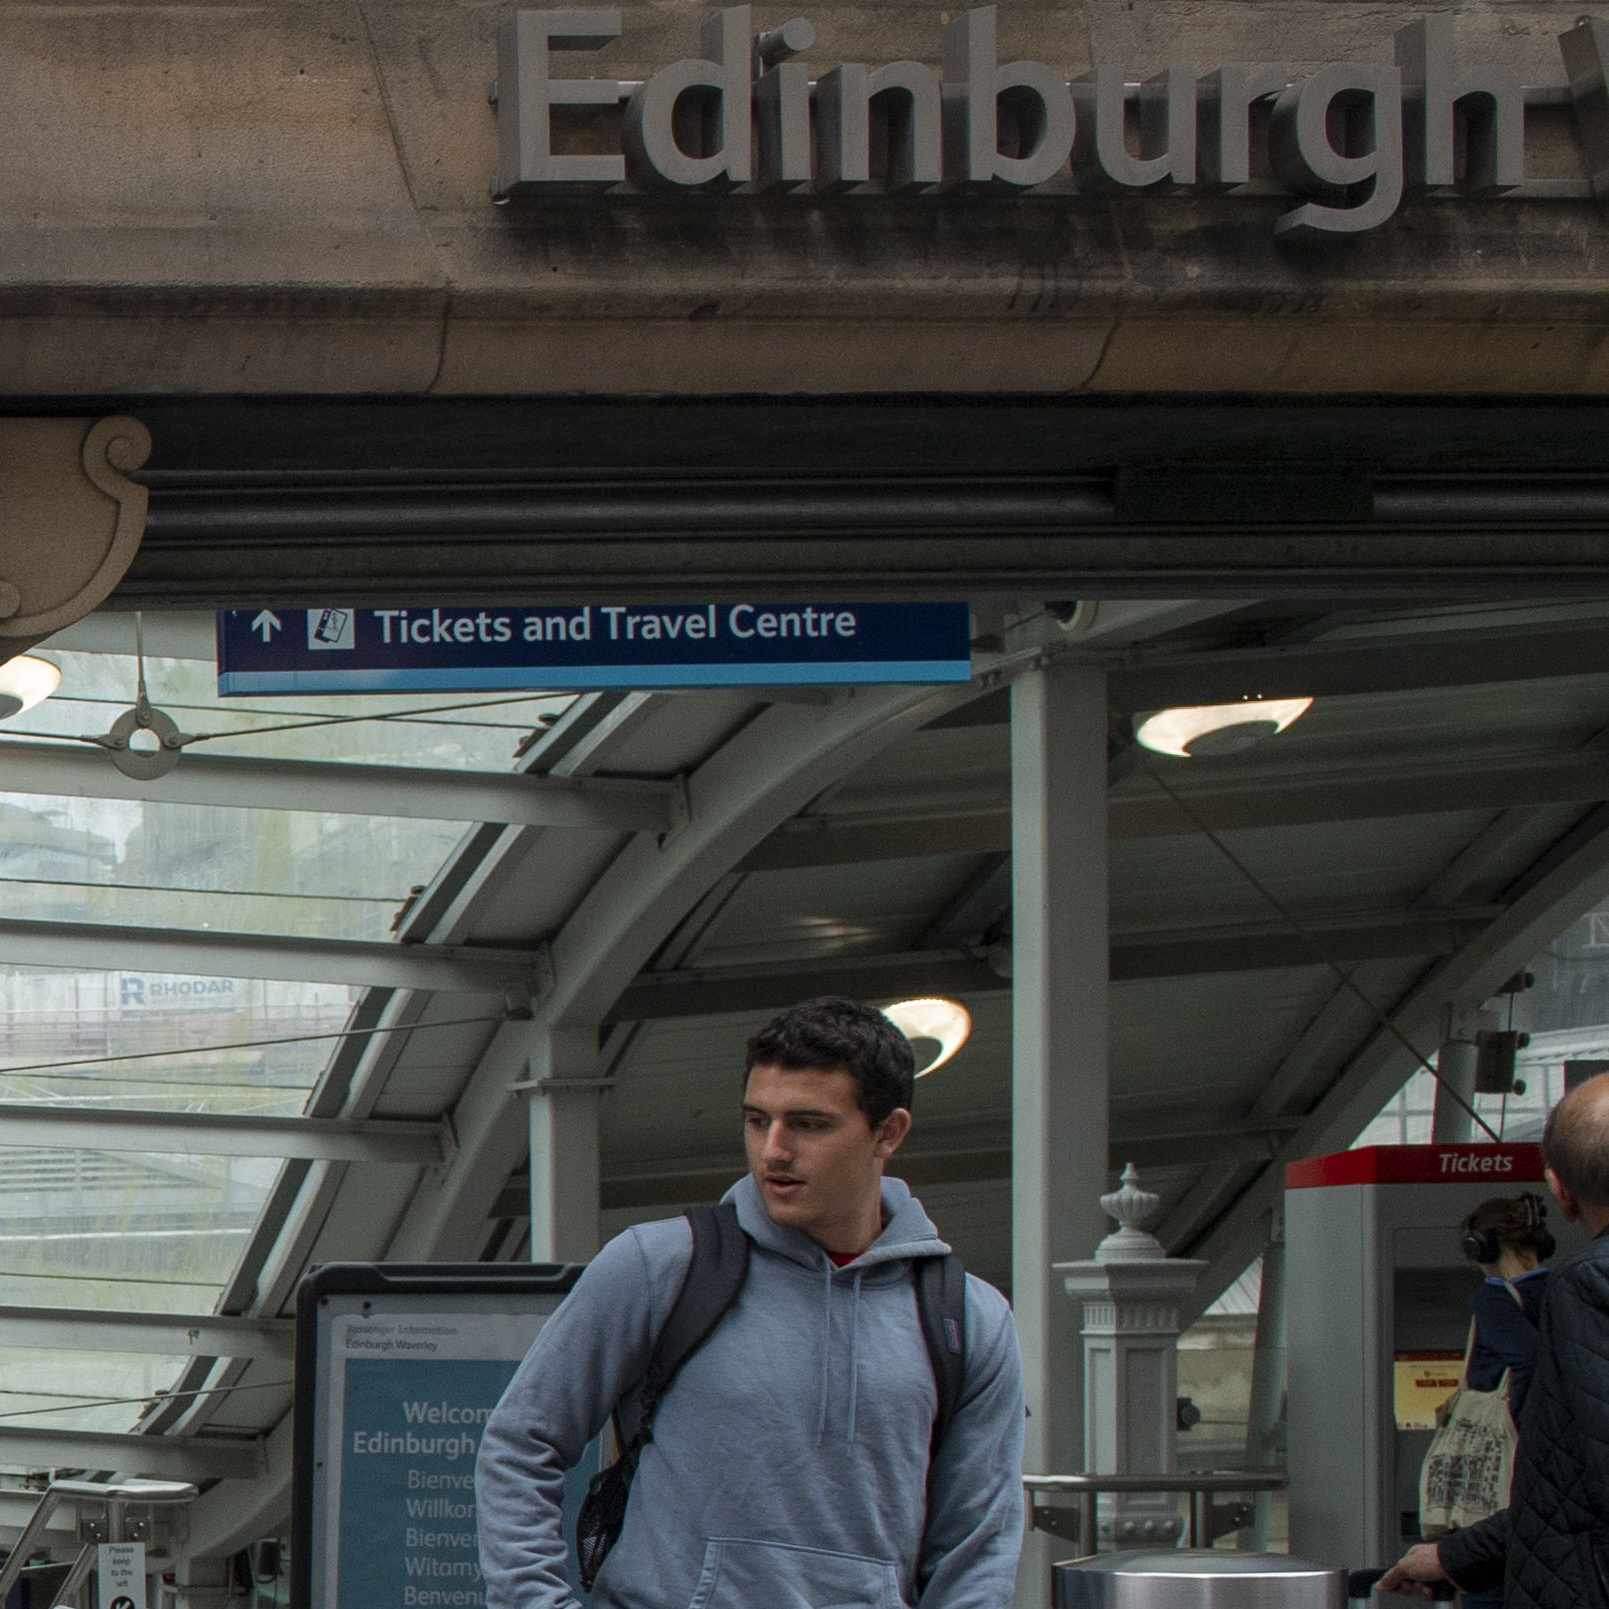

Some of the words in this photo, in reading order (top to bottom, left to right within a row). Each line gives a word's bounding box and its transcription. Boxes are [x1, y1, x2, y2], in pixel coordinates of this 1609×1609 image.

[501, 6, 1526, 234] Edinburgh
[375, 605, 513, 643] Tickets
[523, 605, 590, 641] and
[600, 604, 717, 640] Travel
[728, 604, 857, 639] Centre
[149, 979, 235, 997] RHODAR
[1438, 1153, 1514, 1173] Tickets
[346, 1338, 394, 1351] Edinburgh
[396, 1338, 437, 1352] Waverley
[403, 1401, 492, 1425] Welcom
[353, 1431, 475, 1460] Edinburgh
[408, 1470, 475, 1489] Bienve
[108, 1546, 135, 1554] Please
[405, 1557, 482, 1583] Witamy
